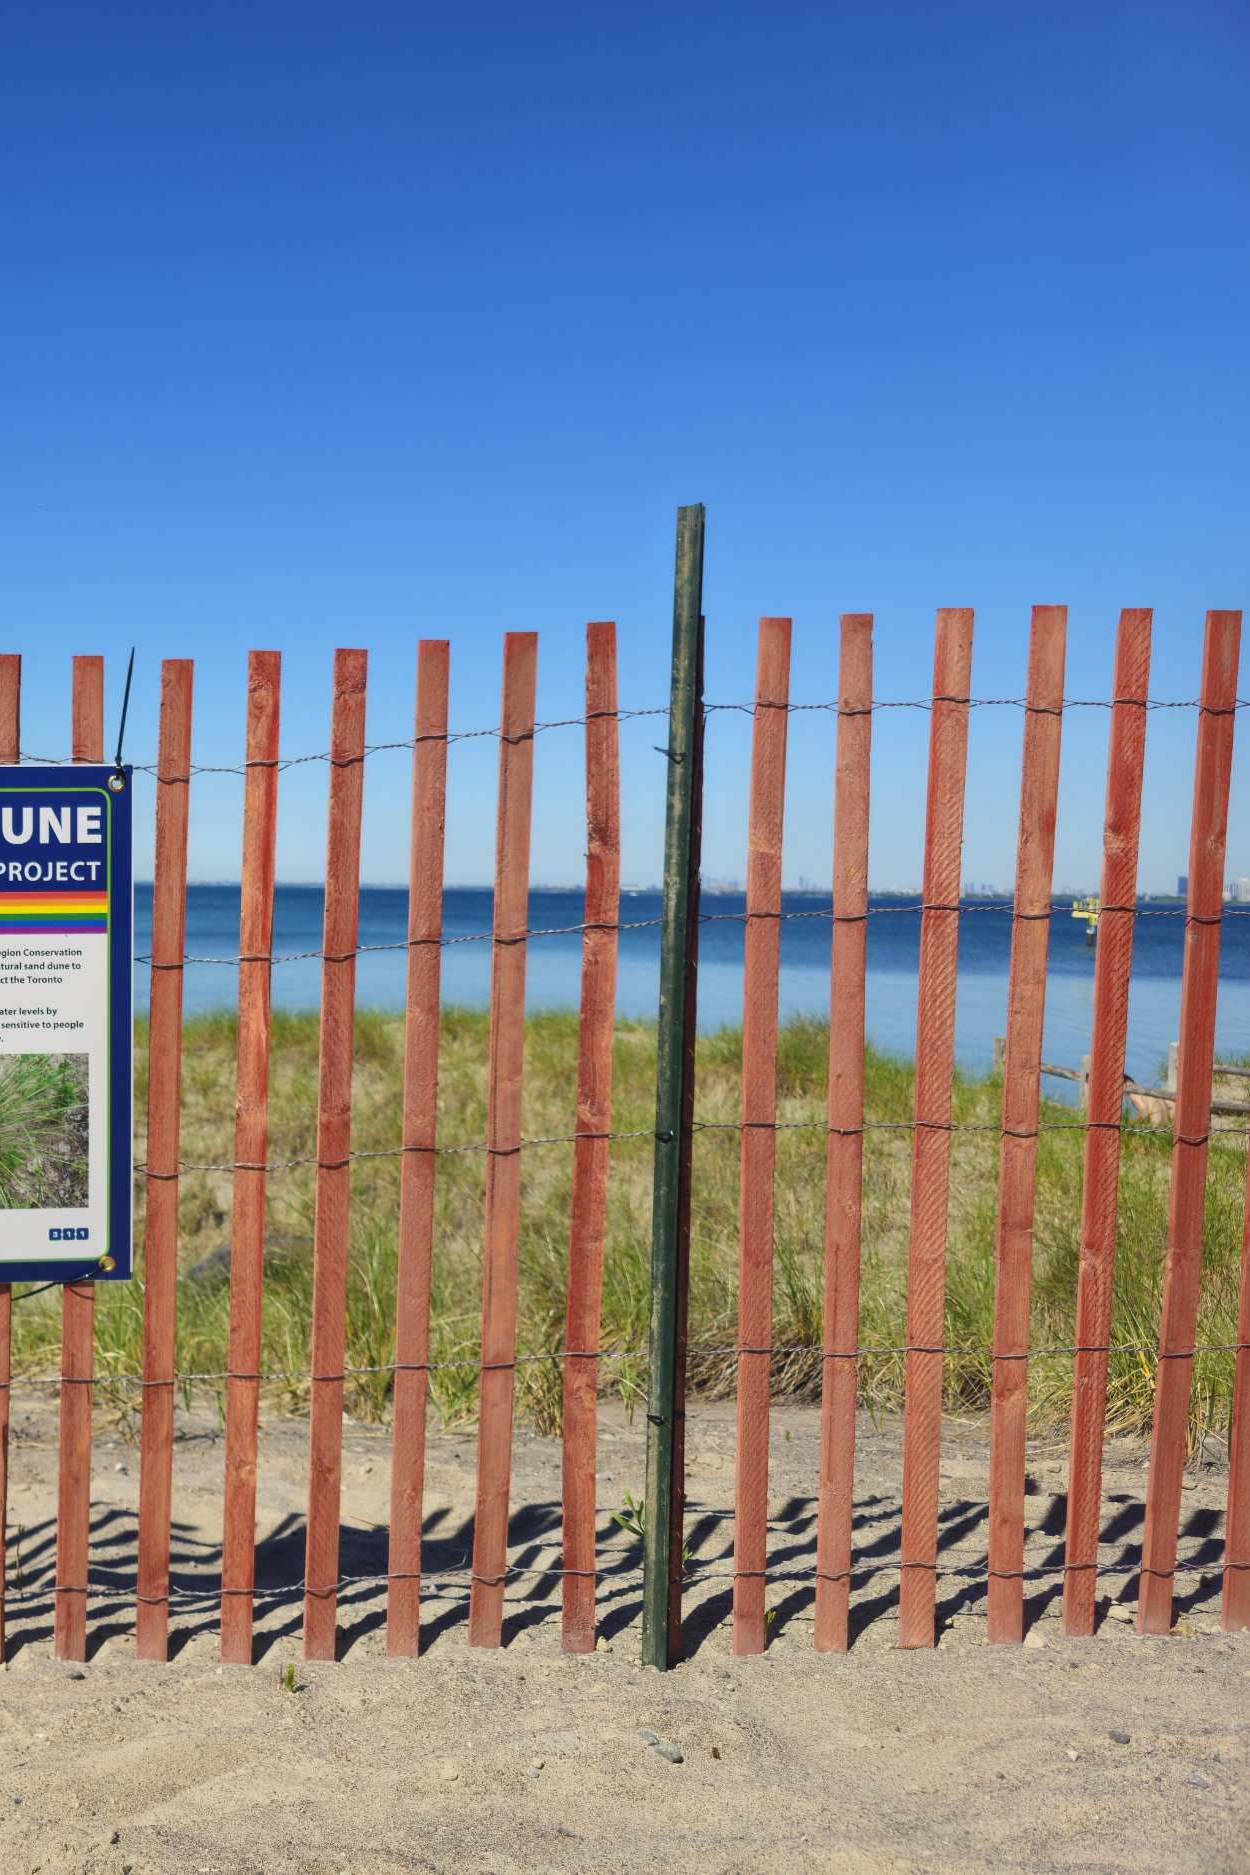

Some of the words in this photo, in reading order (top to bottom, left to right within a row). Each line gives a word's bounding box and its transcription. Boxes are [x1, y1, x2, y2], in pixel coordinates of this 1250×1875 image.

[23, 948, 82, 956] Conservation
[24, 962, 45, 970] sand
[47, 962, 70, 970] dune
[10, 976, 25, 984] the
[27, 976, 63, 984] Toronto
[19, 1007, 44, 1015] levels
[46, 1007, 57, 1017] by
[53, 1020, 84, 1030] people
